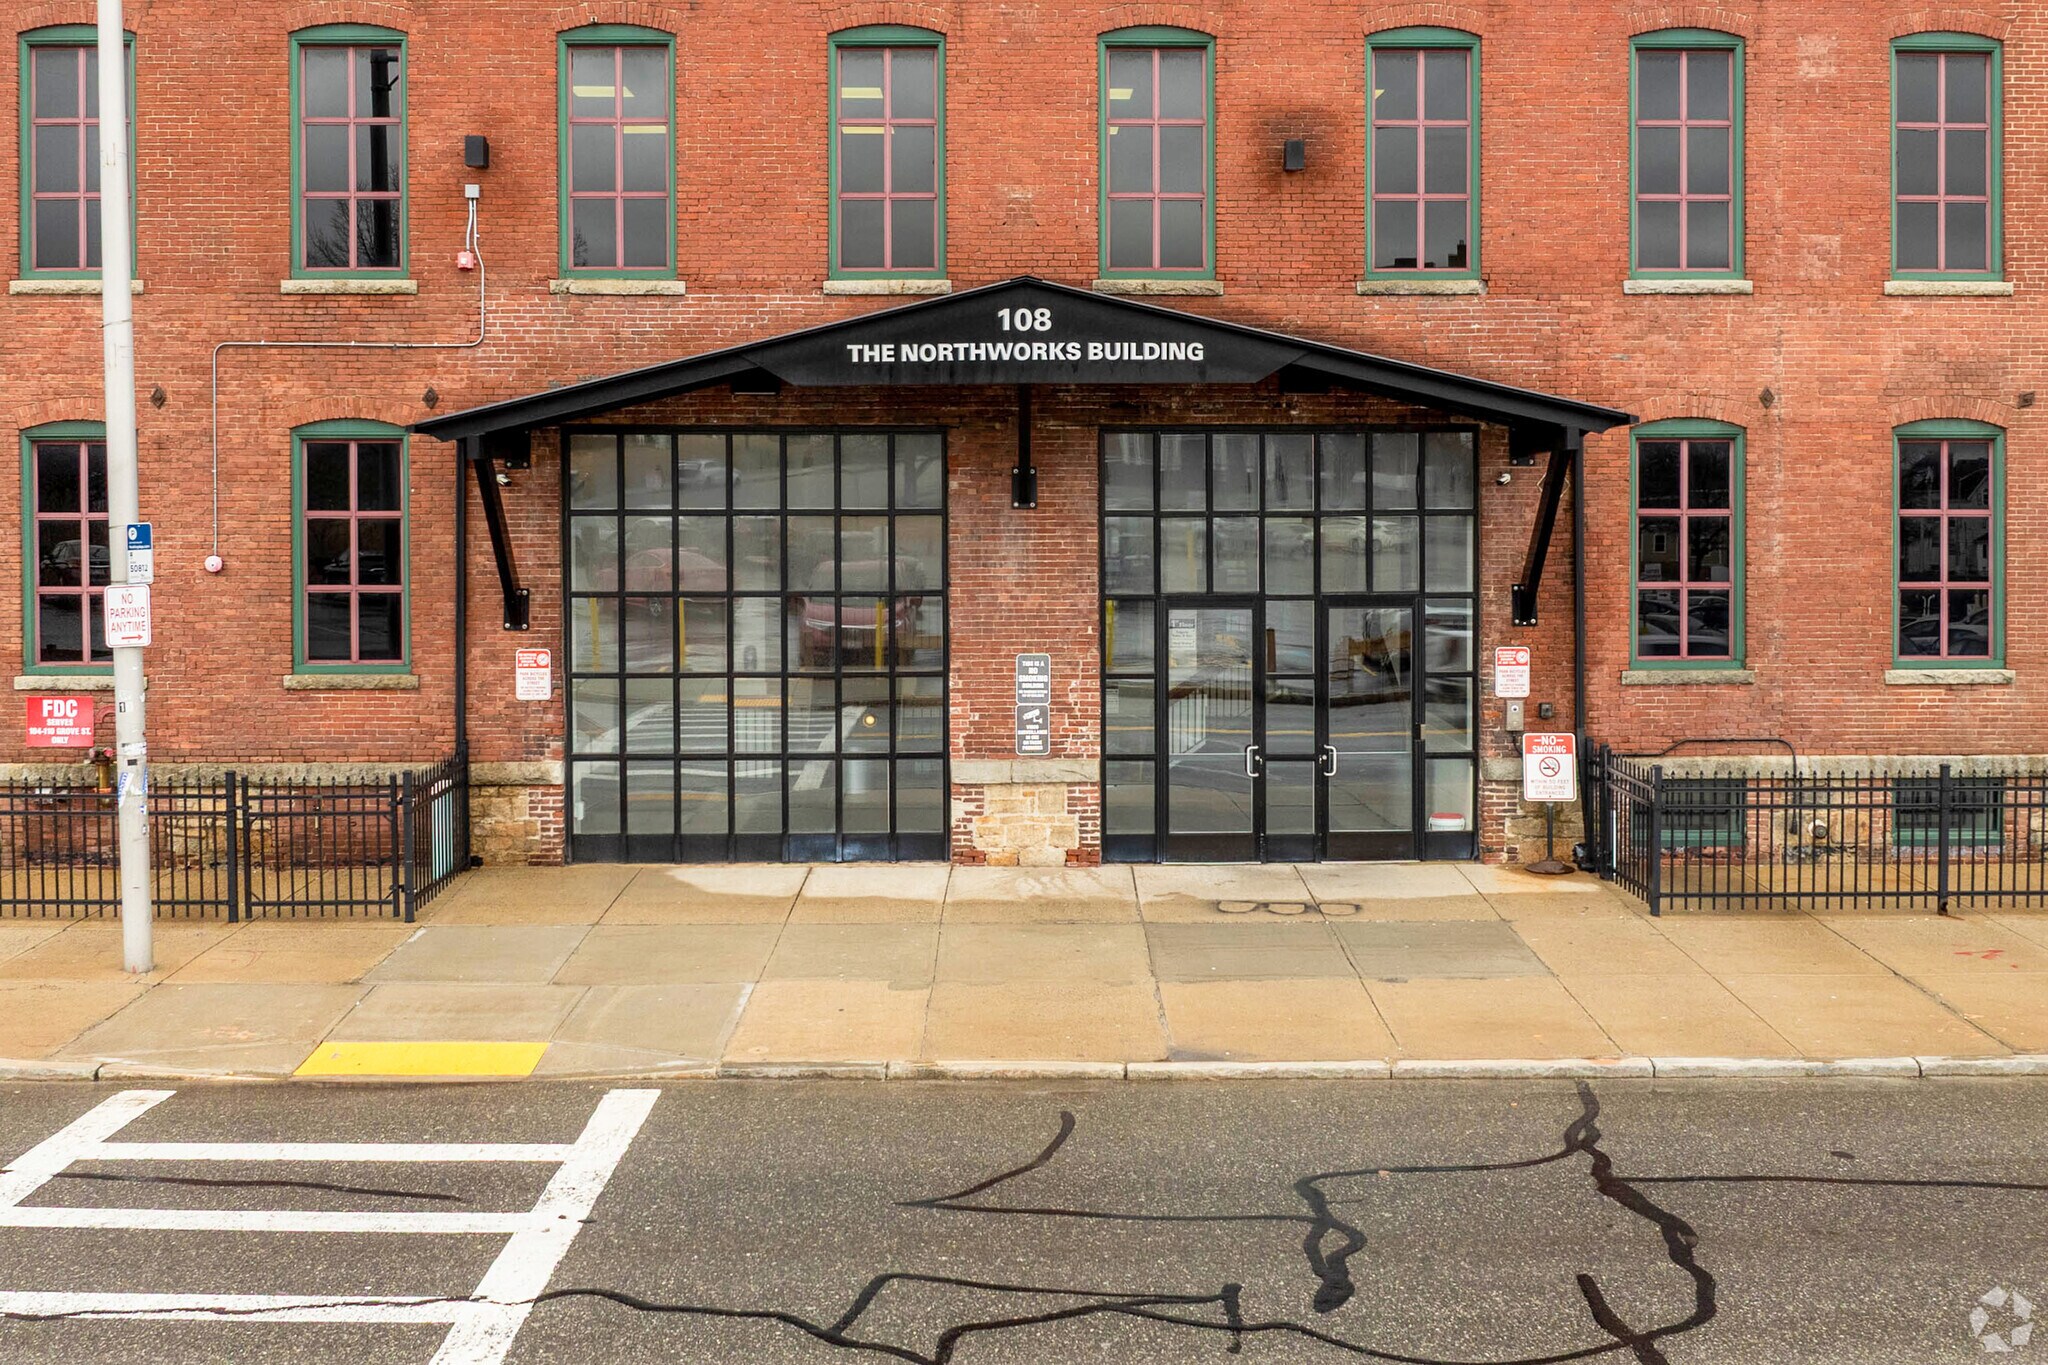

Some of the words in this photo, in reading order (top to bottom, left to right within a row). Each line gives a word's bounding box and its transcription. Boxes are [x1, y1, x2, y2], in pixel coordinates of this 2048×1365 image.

[997, 308, 1052, 331] 108
[847, 344, 896, 362] THE
[901, 342, 1082, 361] NORTHWORKS
[1088, 341, 1204, 361] BUILDING
[121, 593, 133, 604] NO
[110, 607, 146, 619] PARKING
[111, 621, 146, 632] ANYTIME
[42, 699, 78, 717] FDC
[46, 718, 74, 726] SERVES
[56, 727, 80, 735] GROVE
[51, 736, 69, 744] ONLY
[1541, 736, 1557, 745] NO
[1532, 745, 1567, 753] SMOKING
